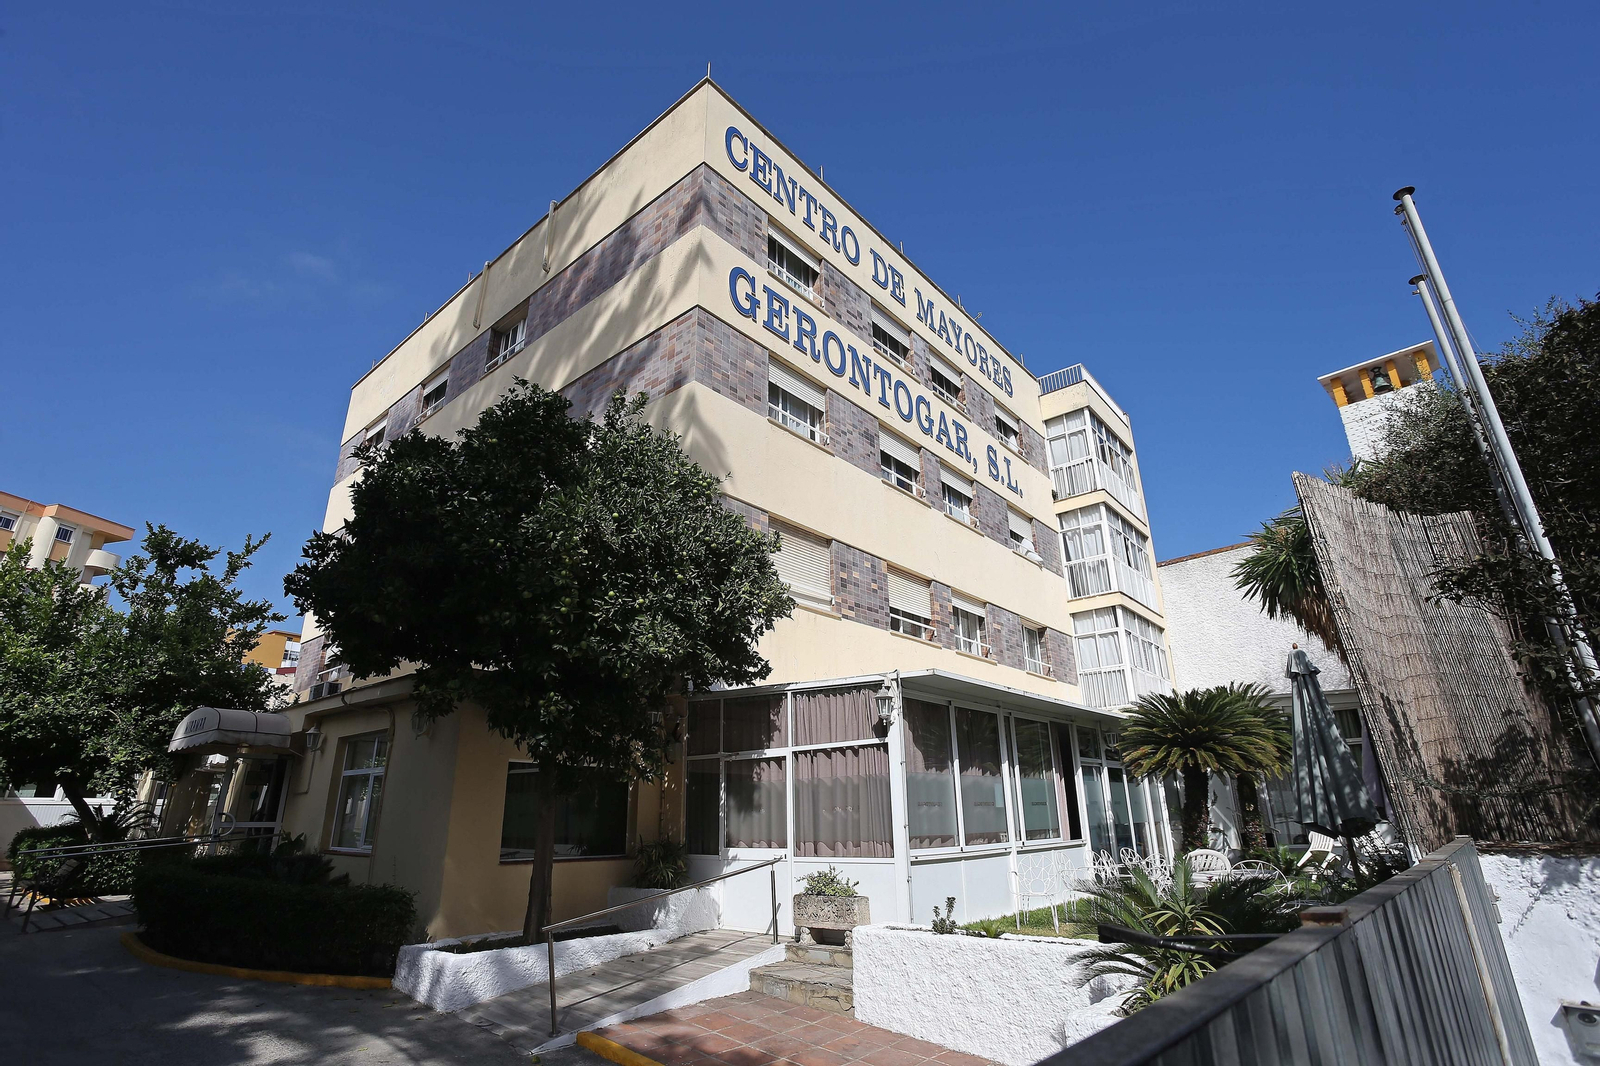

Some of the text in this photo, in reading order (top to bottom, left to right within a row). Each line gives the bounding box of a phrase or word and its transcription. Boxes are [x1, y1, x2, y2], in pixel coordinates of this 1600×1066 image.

[725, 126, 1015, 398] CENTRO DE MAYORES
[728, 266, 1024, 498] GERONTOGAR, S.L.
